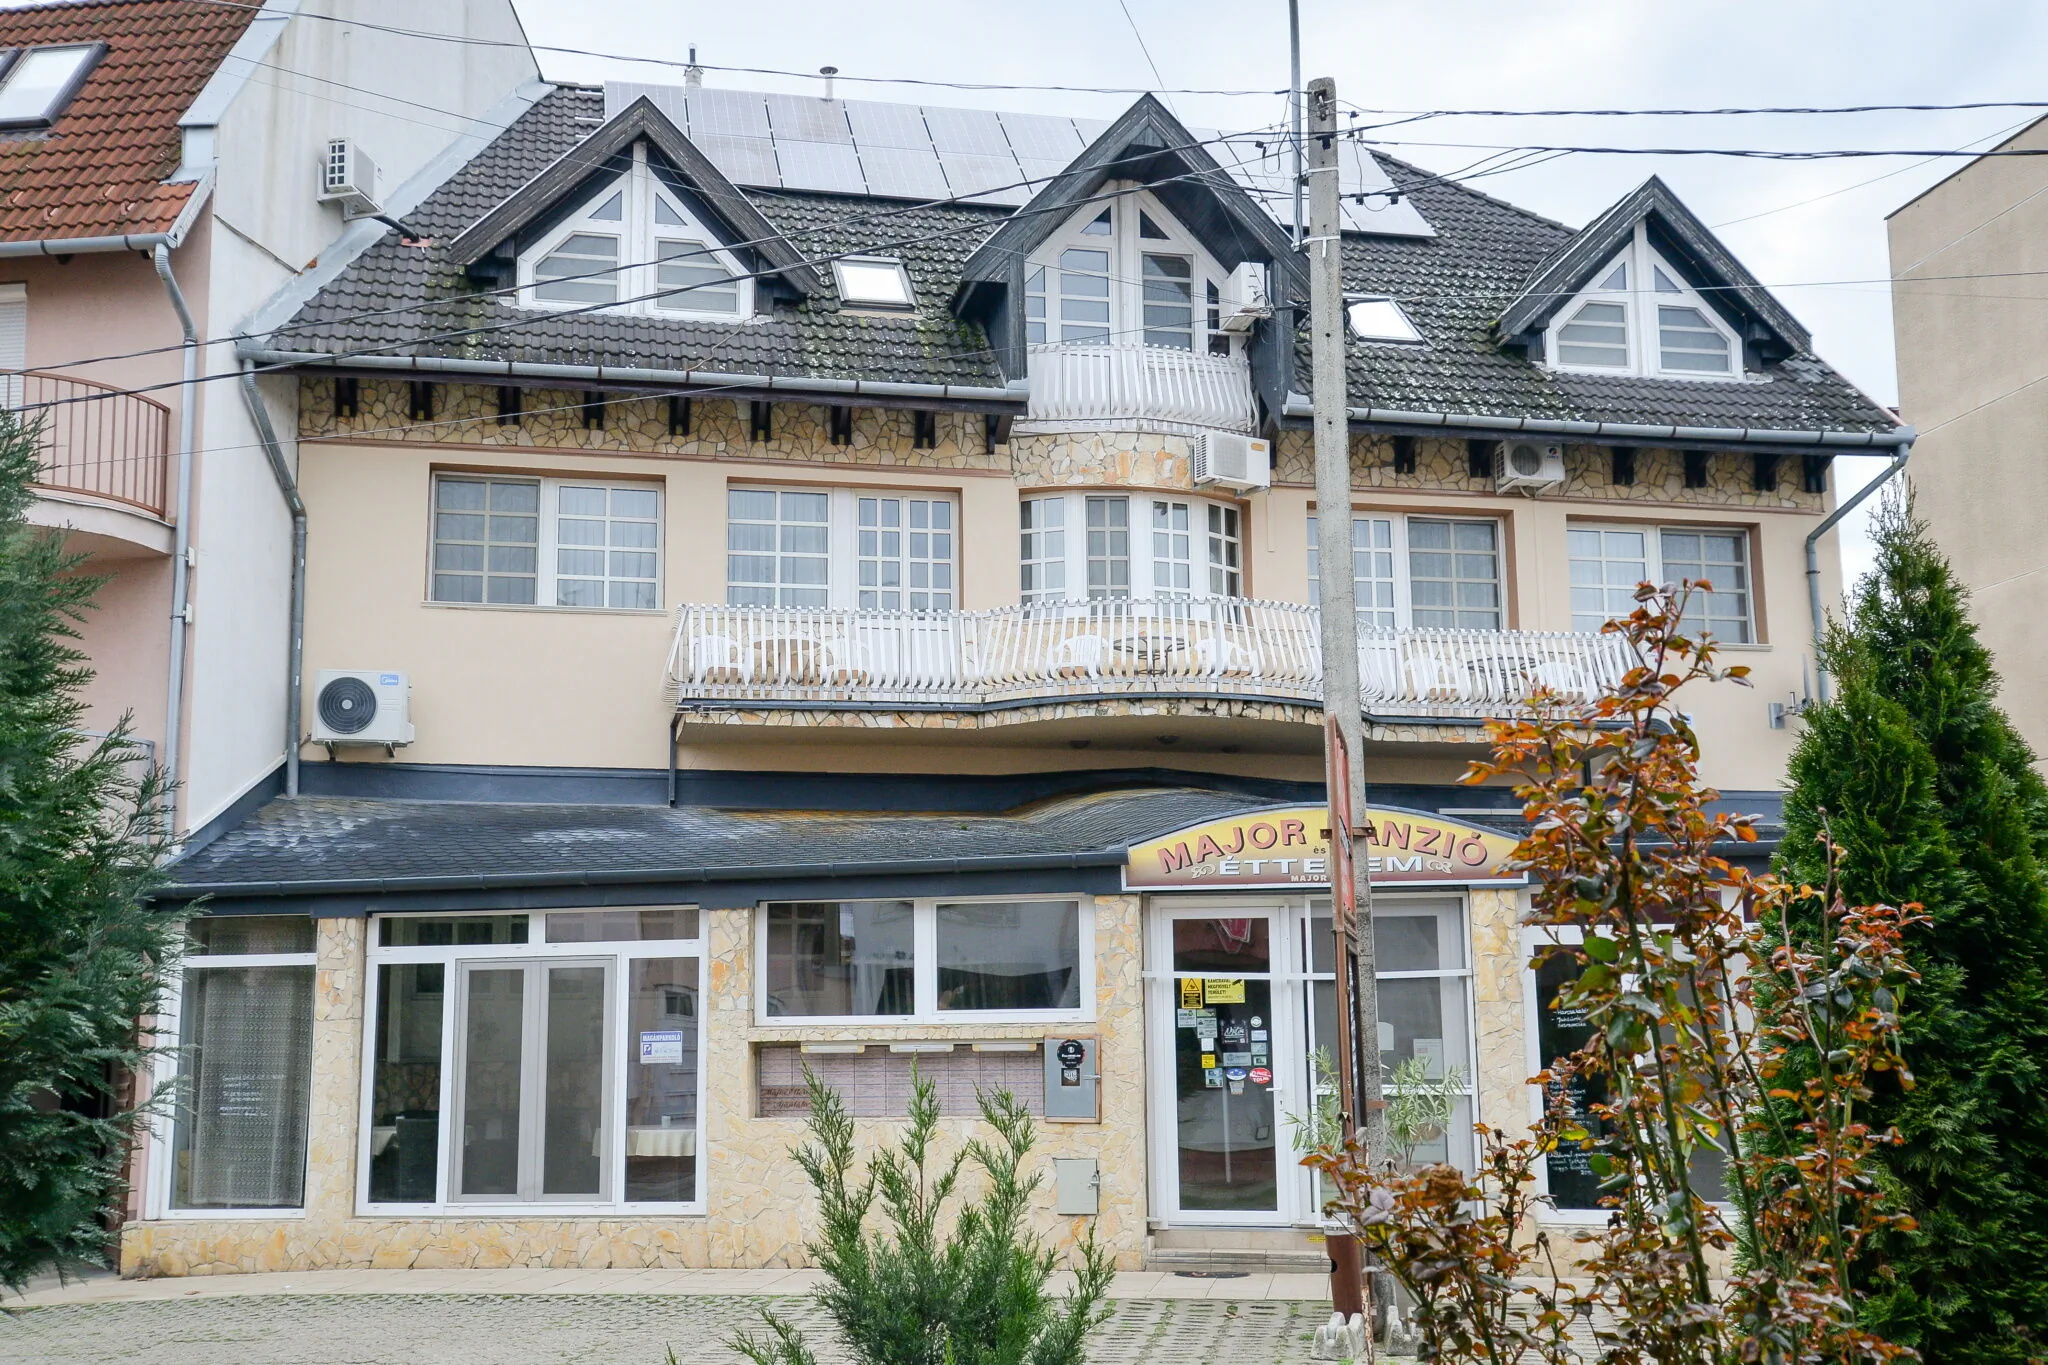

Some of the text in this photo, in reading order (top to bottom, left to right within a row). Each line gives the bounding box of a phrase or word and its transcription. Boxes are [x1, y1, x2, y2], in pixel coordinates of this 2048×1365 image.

[1157, 818, 1488, 874] MAJOR NZIÓ
[1219, 855, 1423, 876] ÉTTEEM
[1290, 874, 1328, 882] MAJOR
